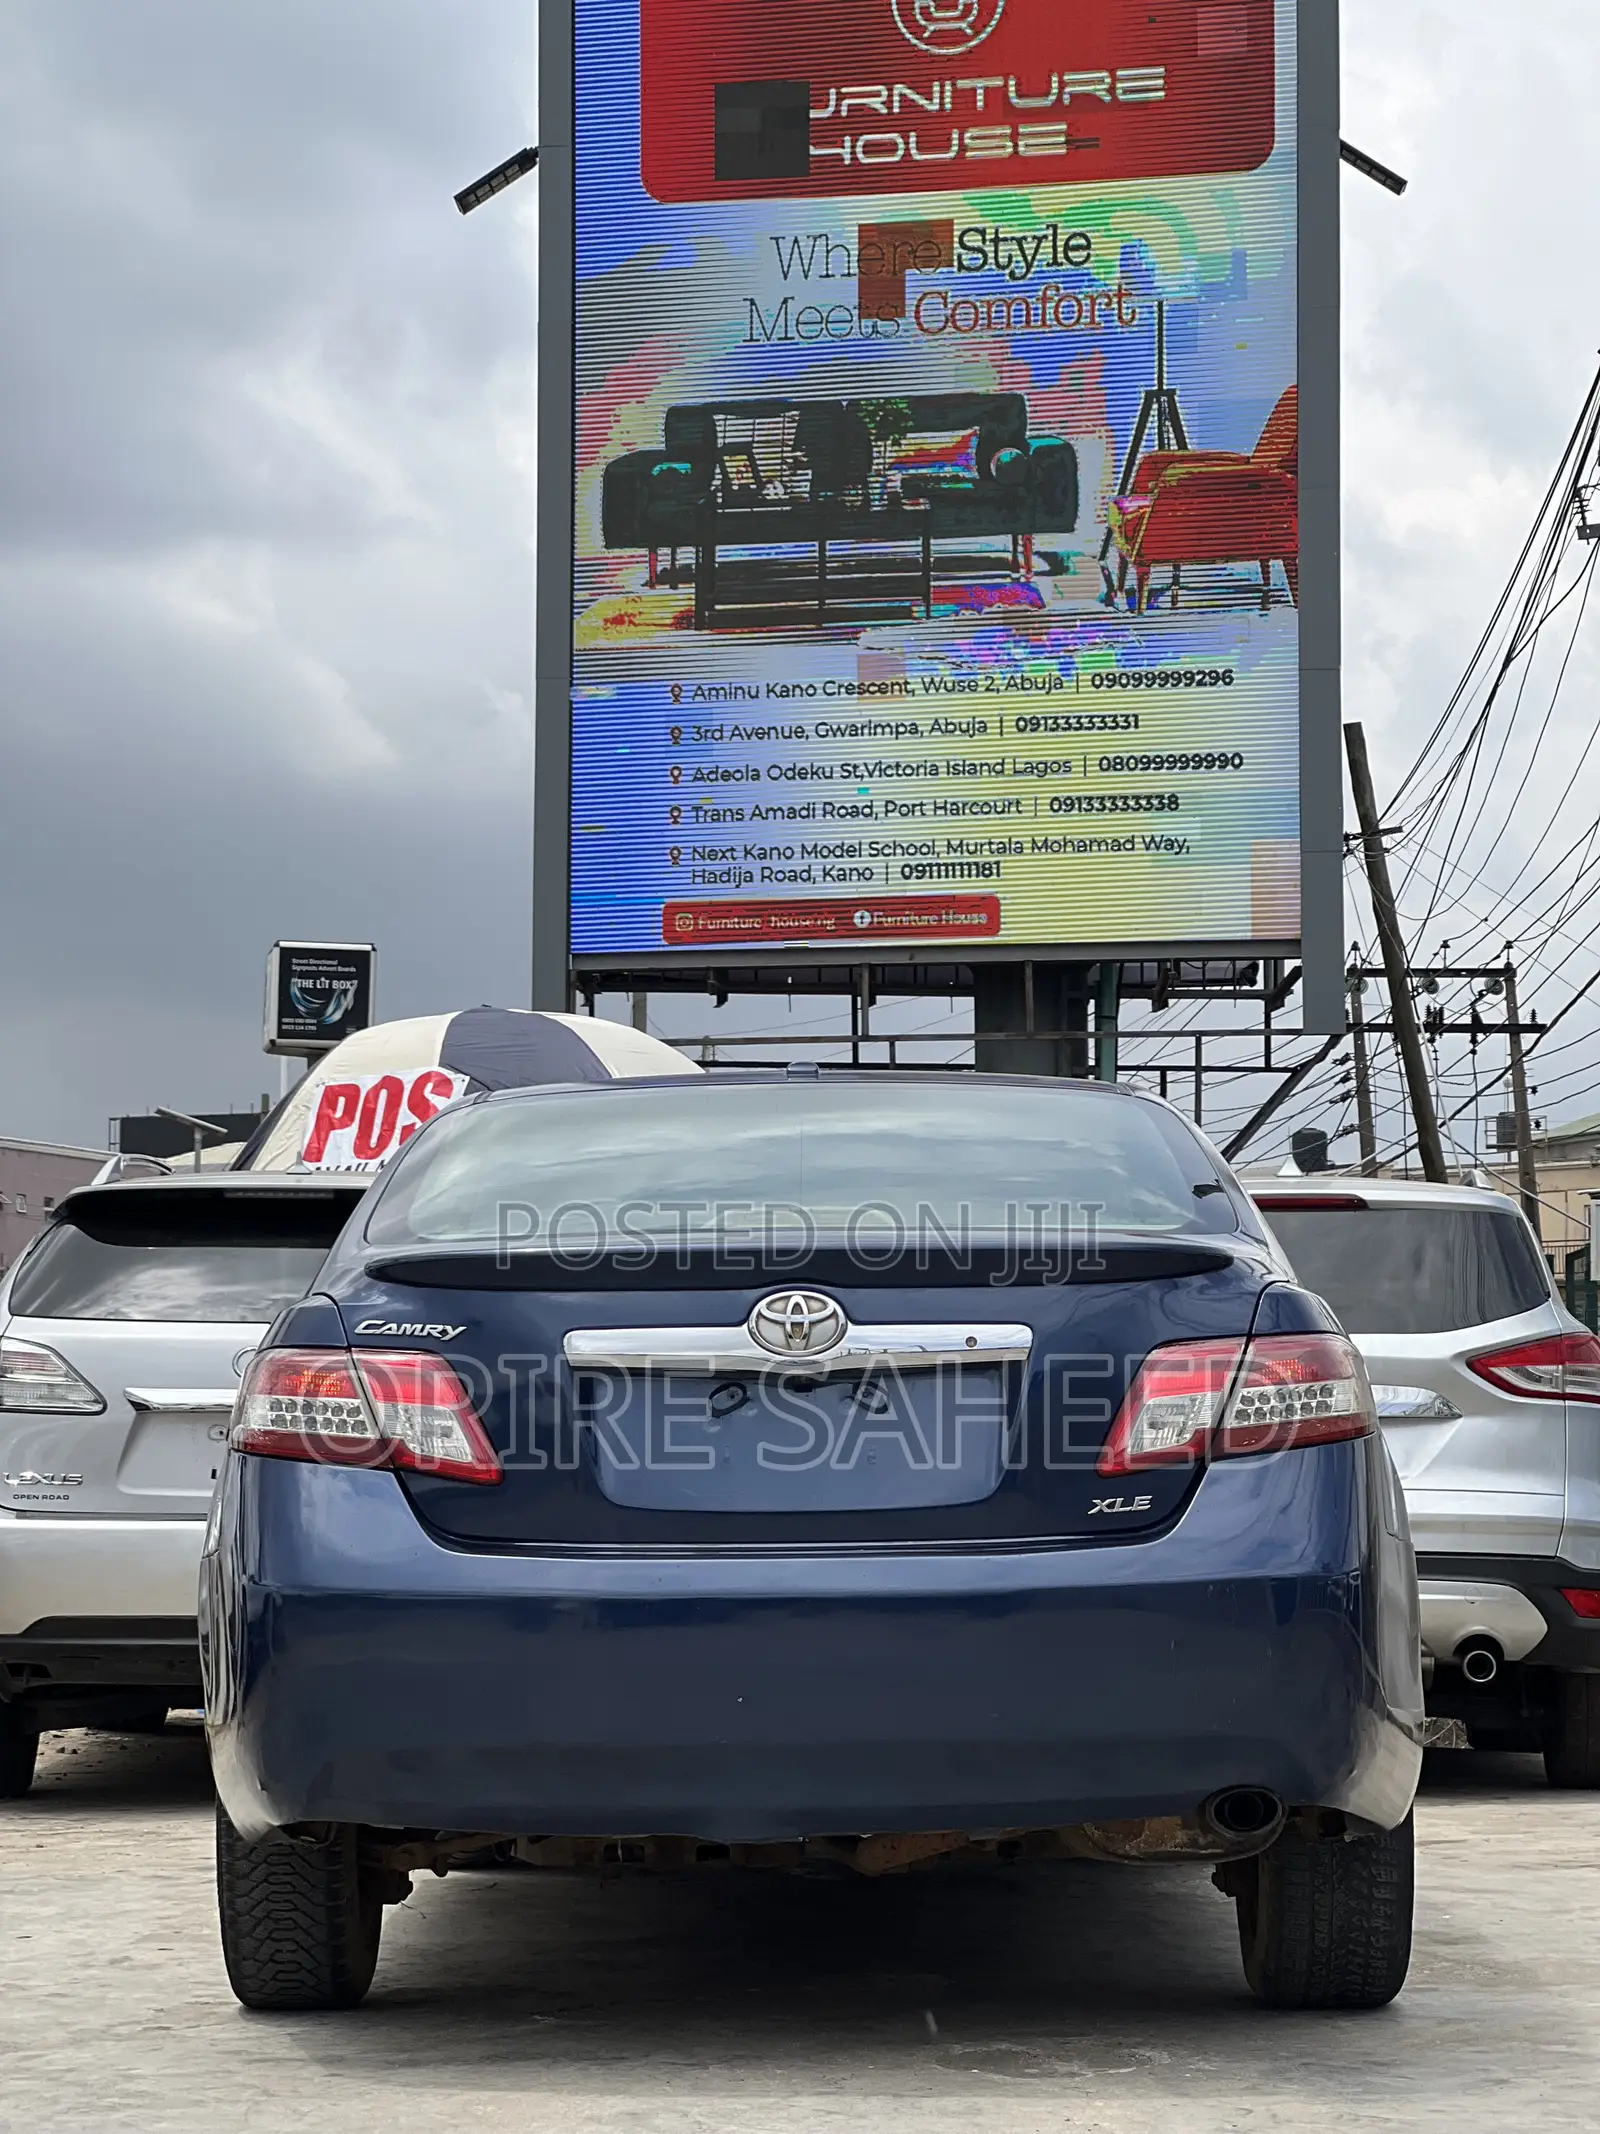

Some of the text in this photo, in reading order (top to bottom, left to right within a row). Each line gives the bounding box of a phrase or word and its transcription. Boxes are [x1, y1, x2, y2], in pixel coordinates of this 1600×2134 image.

[770, 223, 1093, 281] Where Style
[743, 283, 1137, 343] Meets Comfort
[691, 669, 1235, 701] Aminu Kano Crescent, Wuse 2, Abuja 09099999296
[691, 713, 1140, 743] 3rd Avenue, Gwarimpa, Abuja 09133333331
[691, 764, 761, 783] Adeola
[767, 763, 833, 782] Odeku
[945, 758, 1005, 777] Island
[1012, 758, 1072, 778] Lagos
[1098, 752, 1244, 773] 08099999990
[691, 793, 1180, 824] Trans Amadi Road, Port Harcourt 09133333338
[691, 834, 1191, 863] Next Kano Model School, Murtala Mohamad Way,
[691, 867, 754, 889] Hadija
[760, 866, 816, 885] Road,
[822, 865, 875, 883] Kano
[302, 1070, 454, 1163] POS
[354, 1319, 468, 1341] CAMRY
[3, 1471, 83, 1487] LEXUS
[1087, 1495, 1153, 1515] XLE
